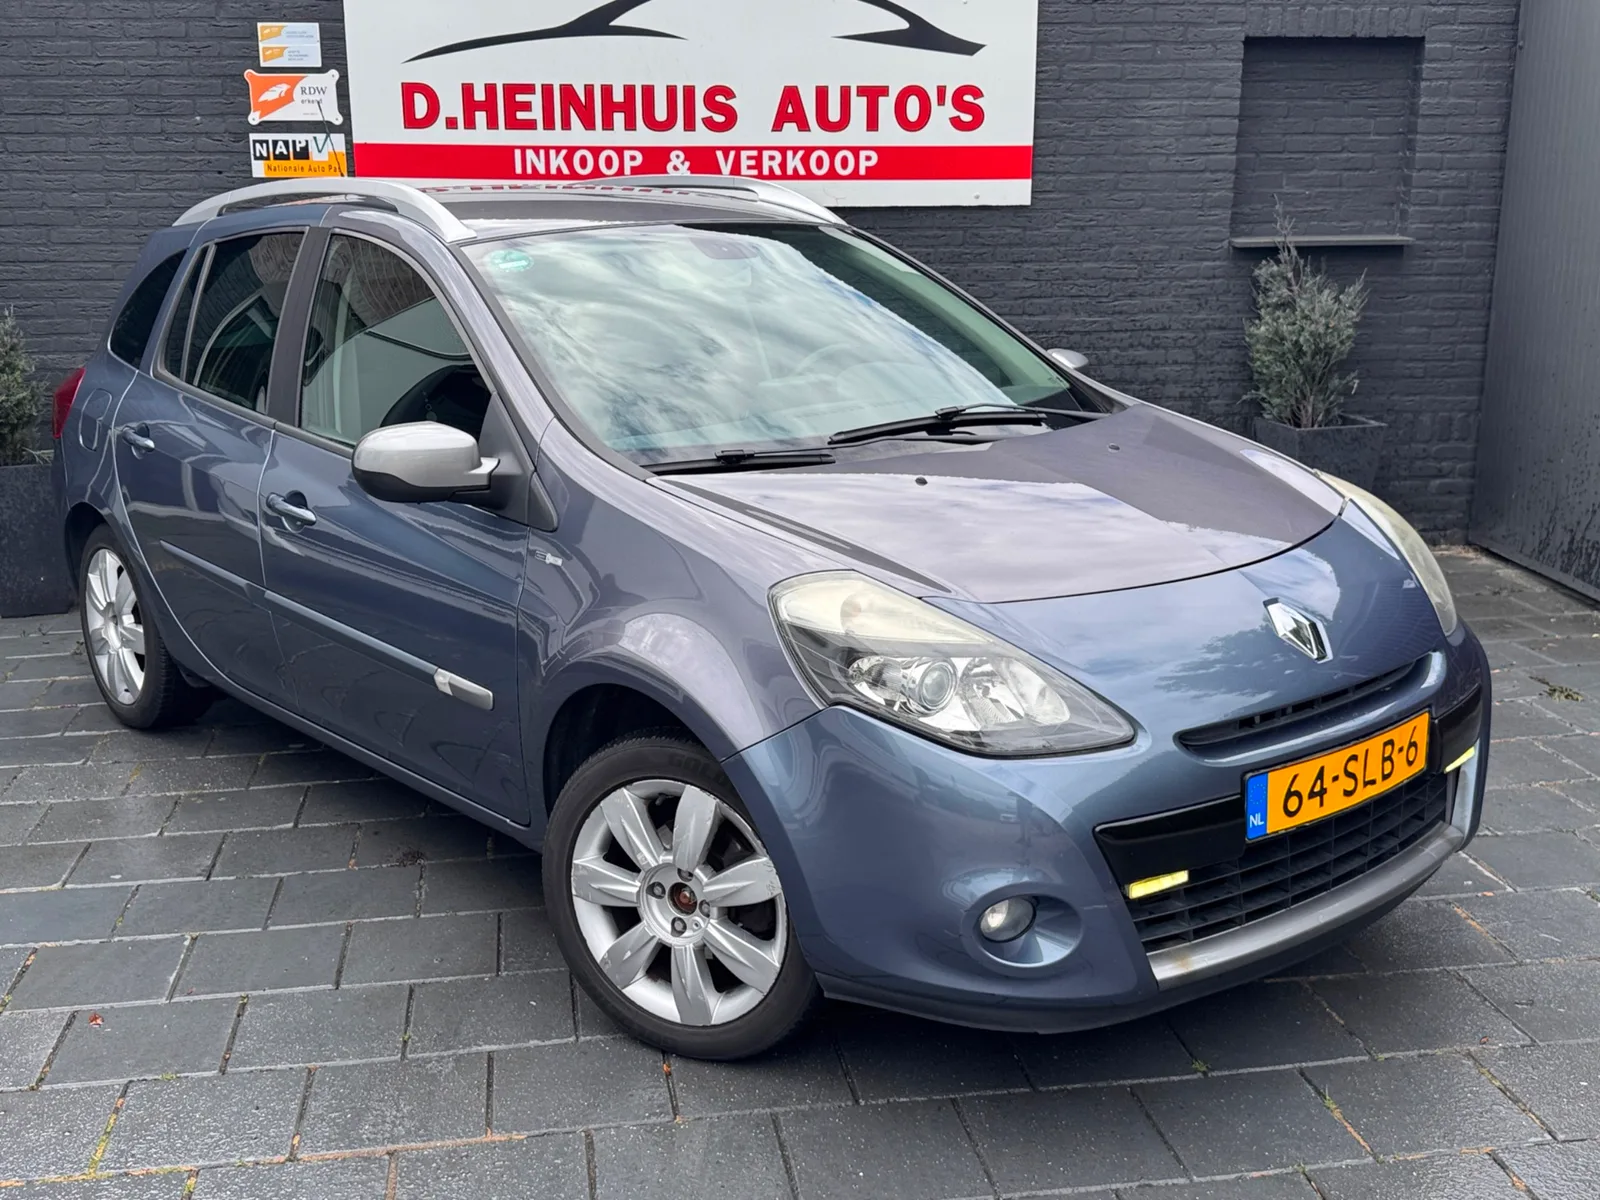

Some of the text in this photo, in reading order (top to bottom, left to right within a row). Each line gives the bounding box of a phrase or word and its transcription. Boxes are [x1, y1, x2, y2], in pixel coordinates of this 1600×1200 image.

[300, 86, 328, 96] RDW
[400, 82, 985, 132] D.HEINHUIS AUTO'S
[267, 164, 305, 173] Nationale
[307, 164, 326, 173] Auto
[514, 148, 878, 176] INKOOP & VERKOOP
[1282, 725, 1418, 818] 64-SLB-6
[1249, 812, 1265, 829] NL
